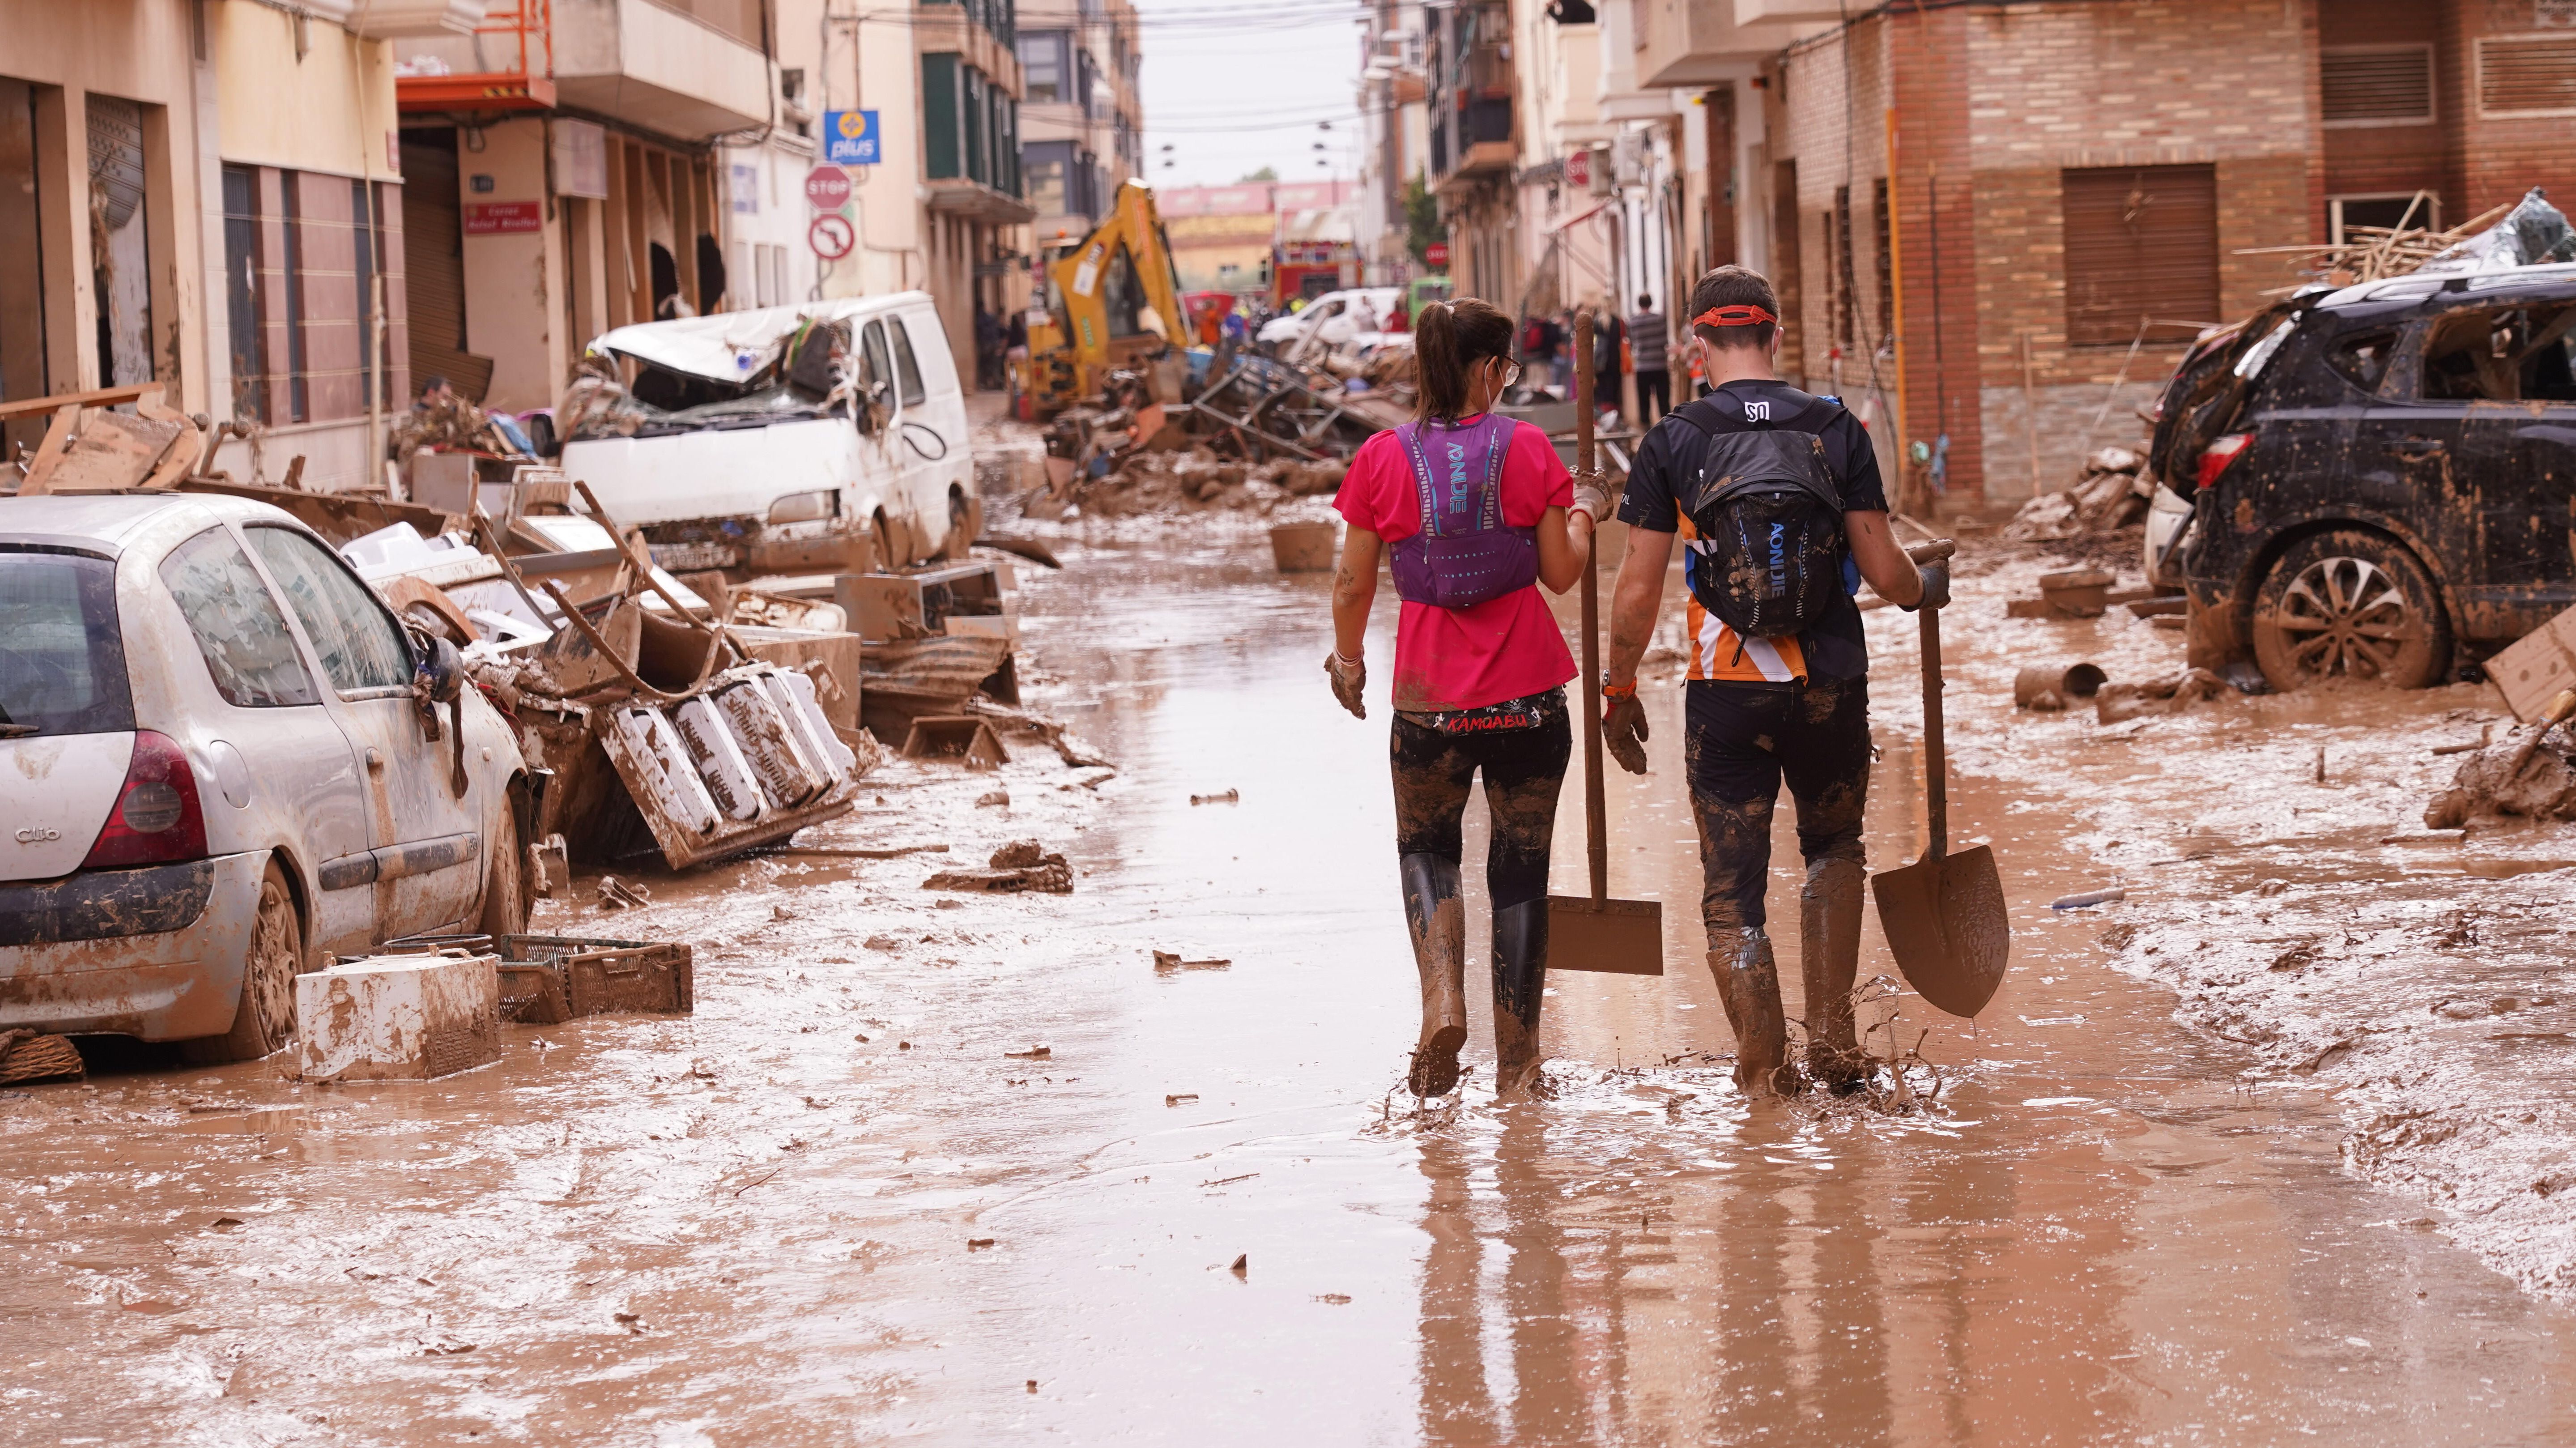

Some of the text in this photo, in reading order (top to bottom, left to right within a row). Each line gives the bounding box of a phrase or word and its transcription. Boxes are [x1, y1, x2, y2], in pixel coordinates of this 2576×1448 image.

[831, 139, 875, 160] plus
[809, 180, 849, 194] STOP
[1769, 522, 1785, 598] AONIJIE
[14, 826, 61, 843] Clio
